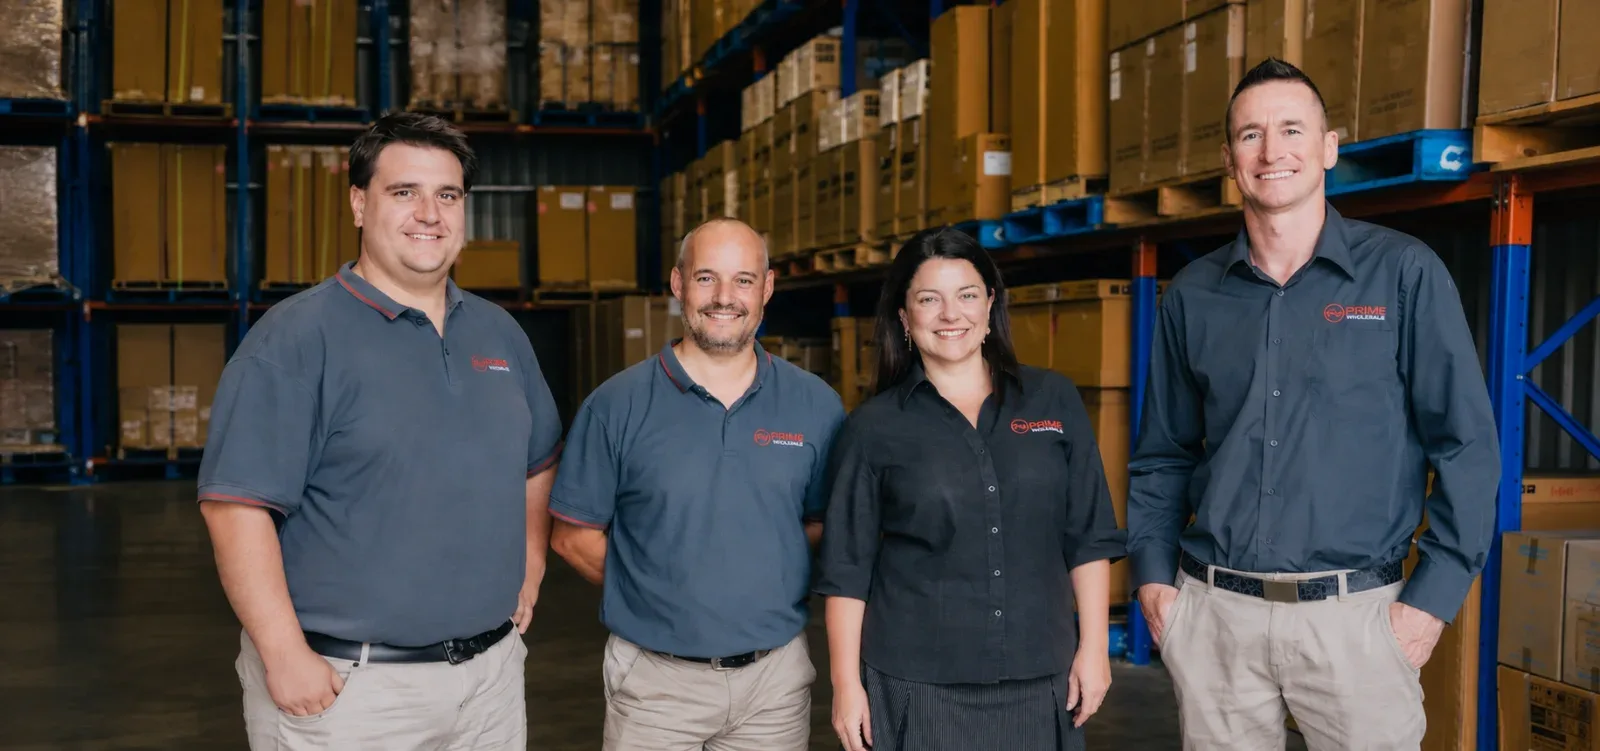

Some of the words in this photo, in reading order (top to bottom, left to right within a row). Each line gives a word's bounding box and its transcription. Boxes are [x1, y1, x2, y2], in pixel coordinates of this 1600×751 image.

[1345, 306, 1387, 315] PRIME
[1028, 419, 1064, 430] PRIME
[771, 431, 804, 441] PRIME
